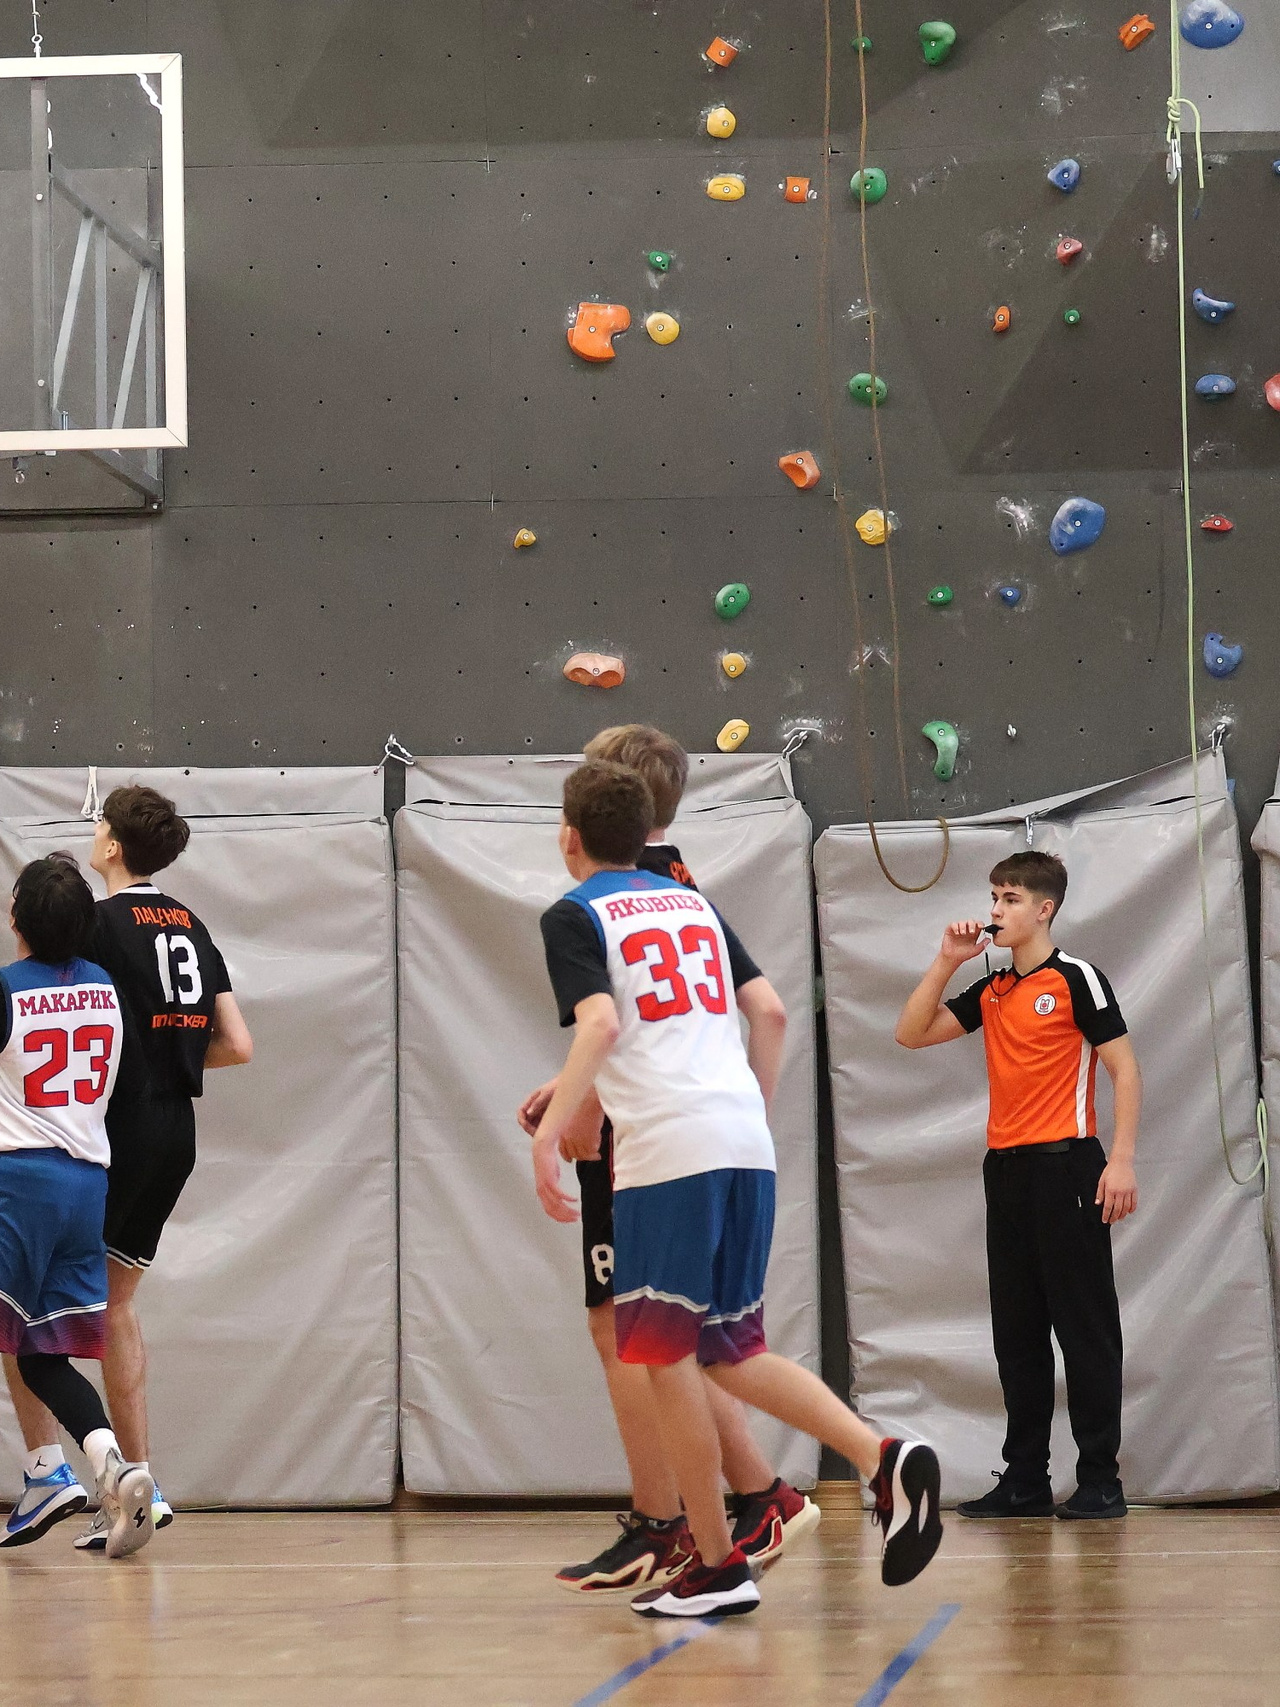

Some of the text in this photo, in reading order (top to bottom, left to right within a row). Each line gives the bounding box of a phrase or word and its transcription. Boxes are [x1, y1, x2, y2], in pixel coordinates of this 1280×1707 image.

[605, 894, 704, 921] ЯКОВЛЕВ
[17, 990, 116, 1016] МАКАРИК
[154, 932, 203, 1004] 13
[620, 924, 728, 1022] 33
[23, 1024, 114, 1108] 23
